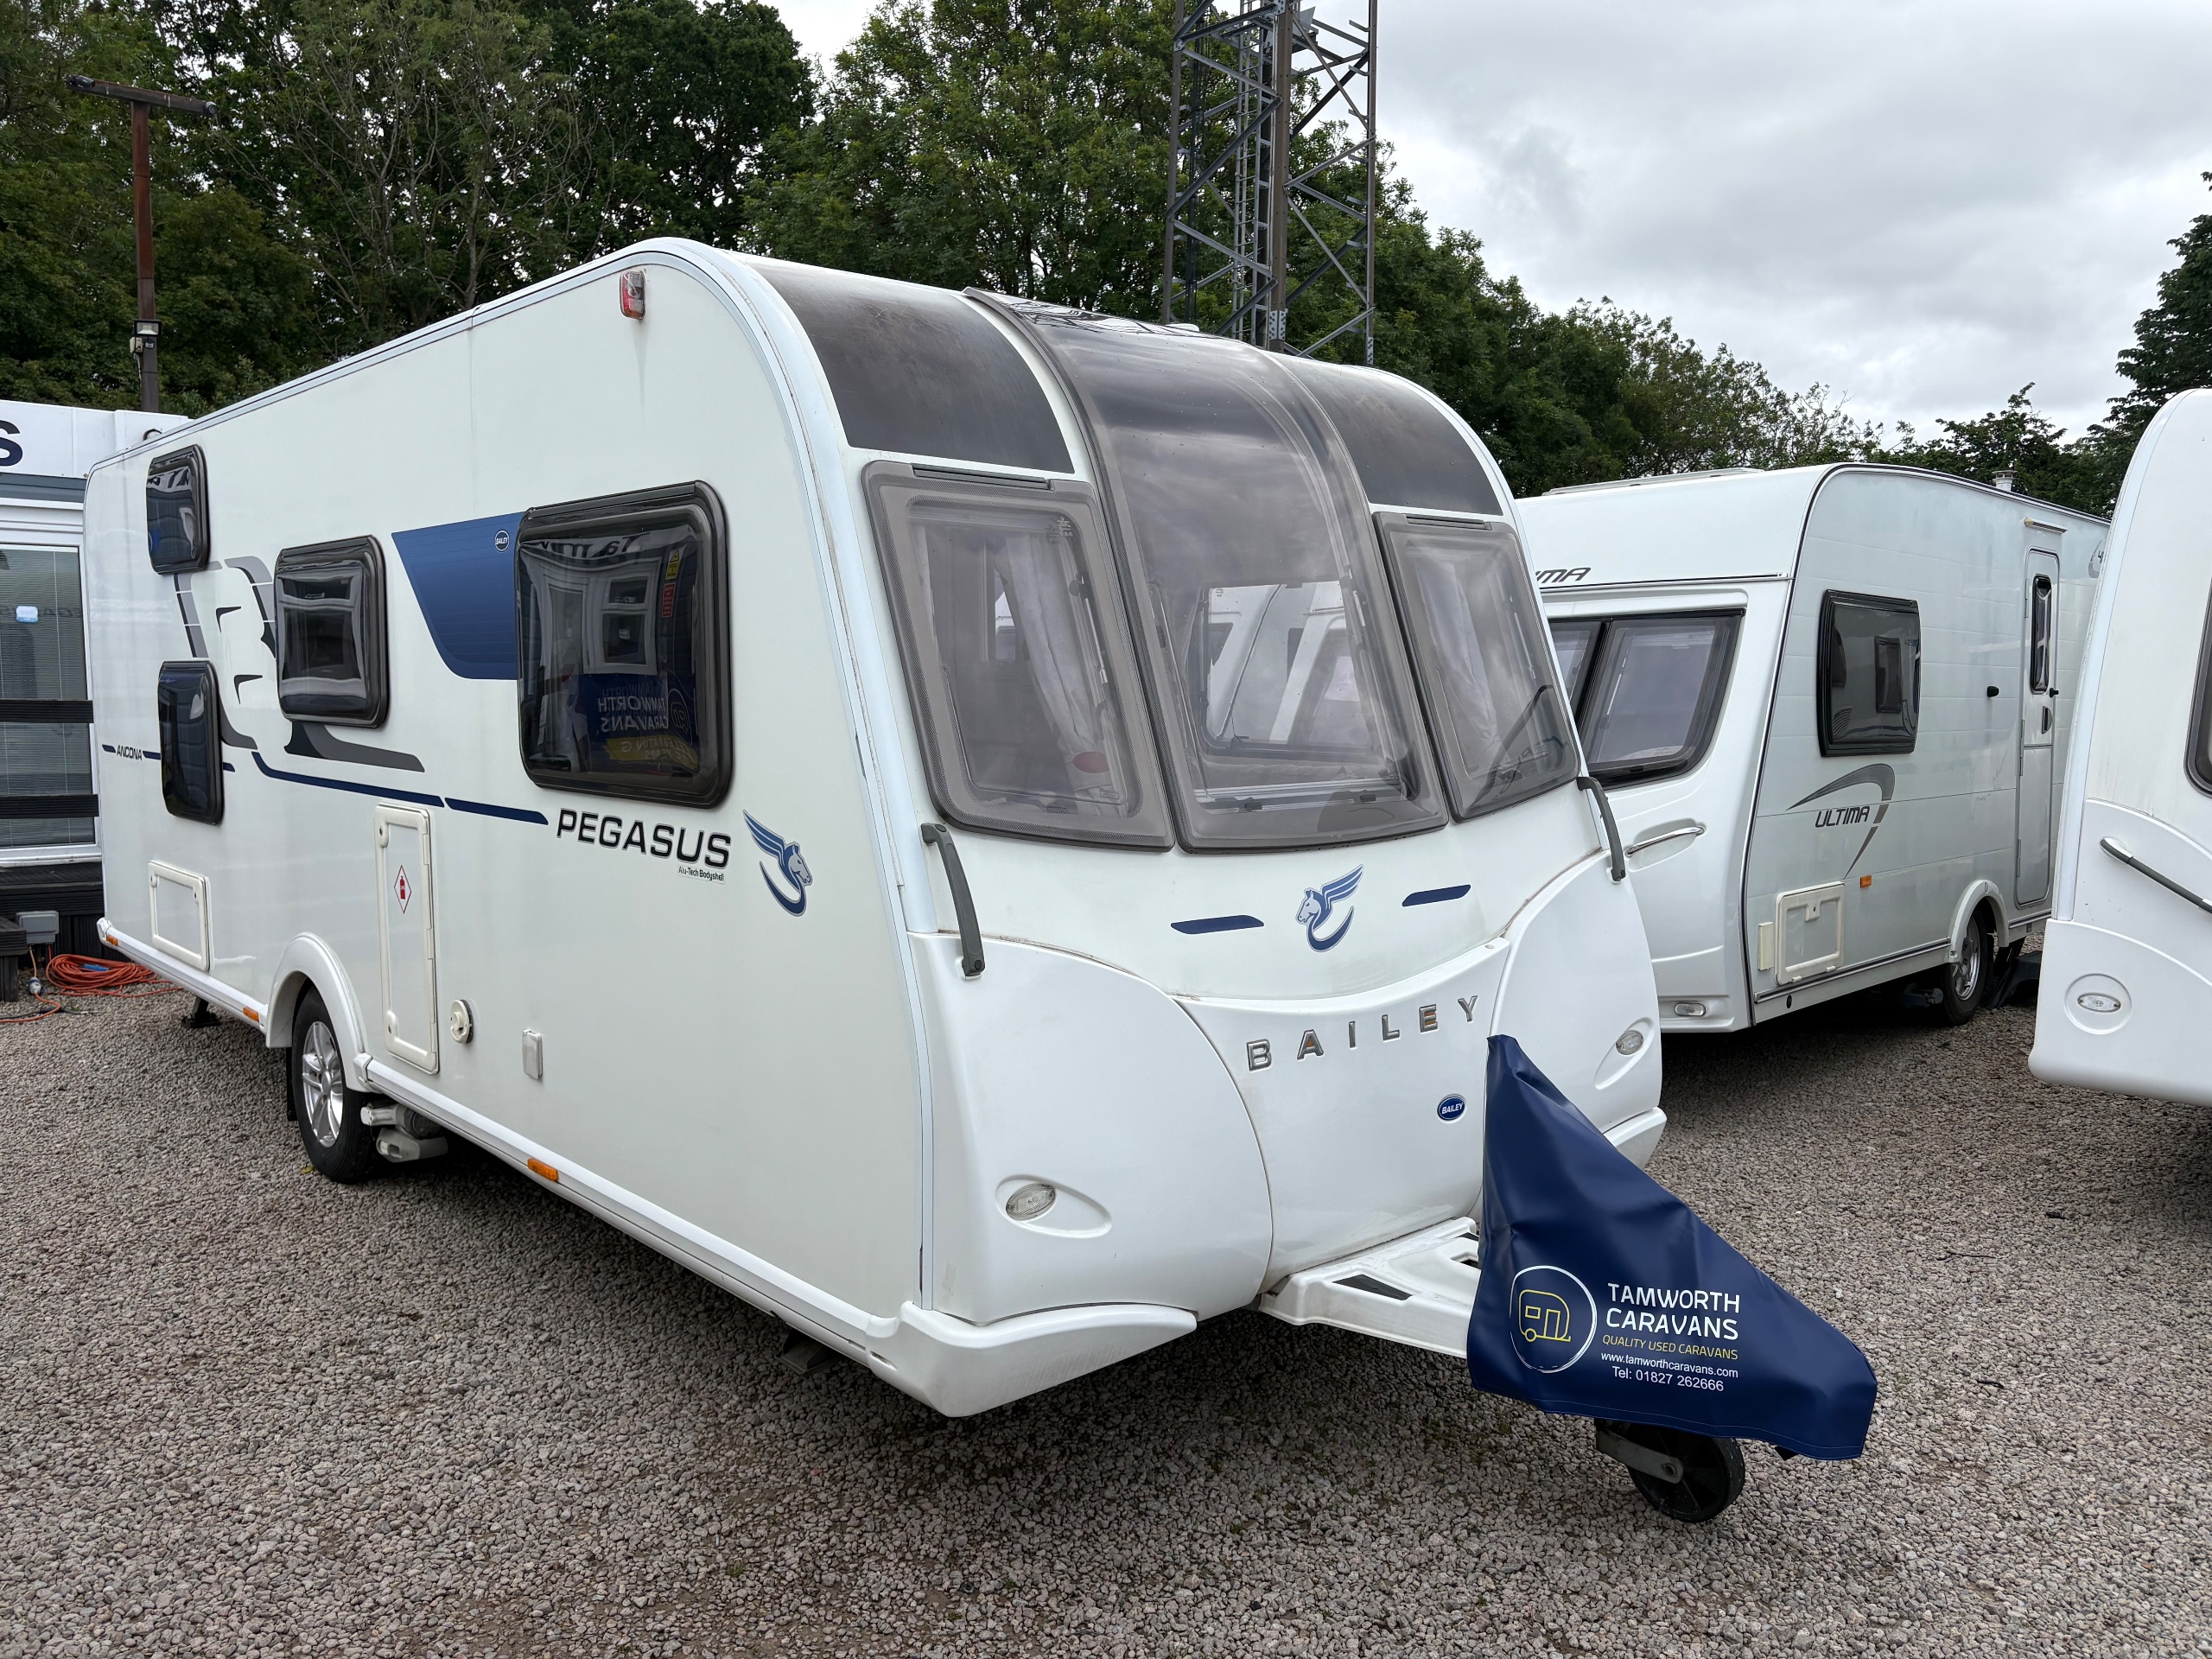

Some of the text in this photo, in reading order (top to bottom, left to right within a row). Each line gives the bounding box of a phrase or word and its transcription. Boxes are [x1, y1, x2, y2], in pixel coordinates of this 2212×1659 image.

[117, 745, 143, 760] ANCONA
[1815, 805, 1870, 828] ULTIMA
[556, 808, 731, 869] PEGASUS
[1246, 995, 1478, 1071] BAILEY
[1441, 1103, 1464, 1115] BAILEY
[1607, 1282, 1740, 1313] TAMWORTH
[1606, 1307, 1738, 1340] CARAVANS
[1602, 1334, 1738, 1360] QUALITY USED CARAVANS
[1601, 1352, 1738, 1378] www.tamworthcaravans.com
[1612, 1366, 1724, 1392] Tel: 01827 262666
